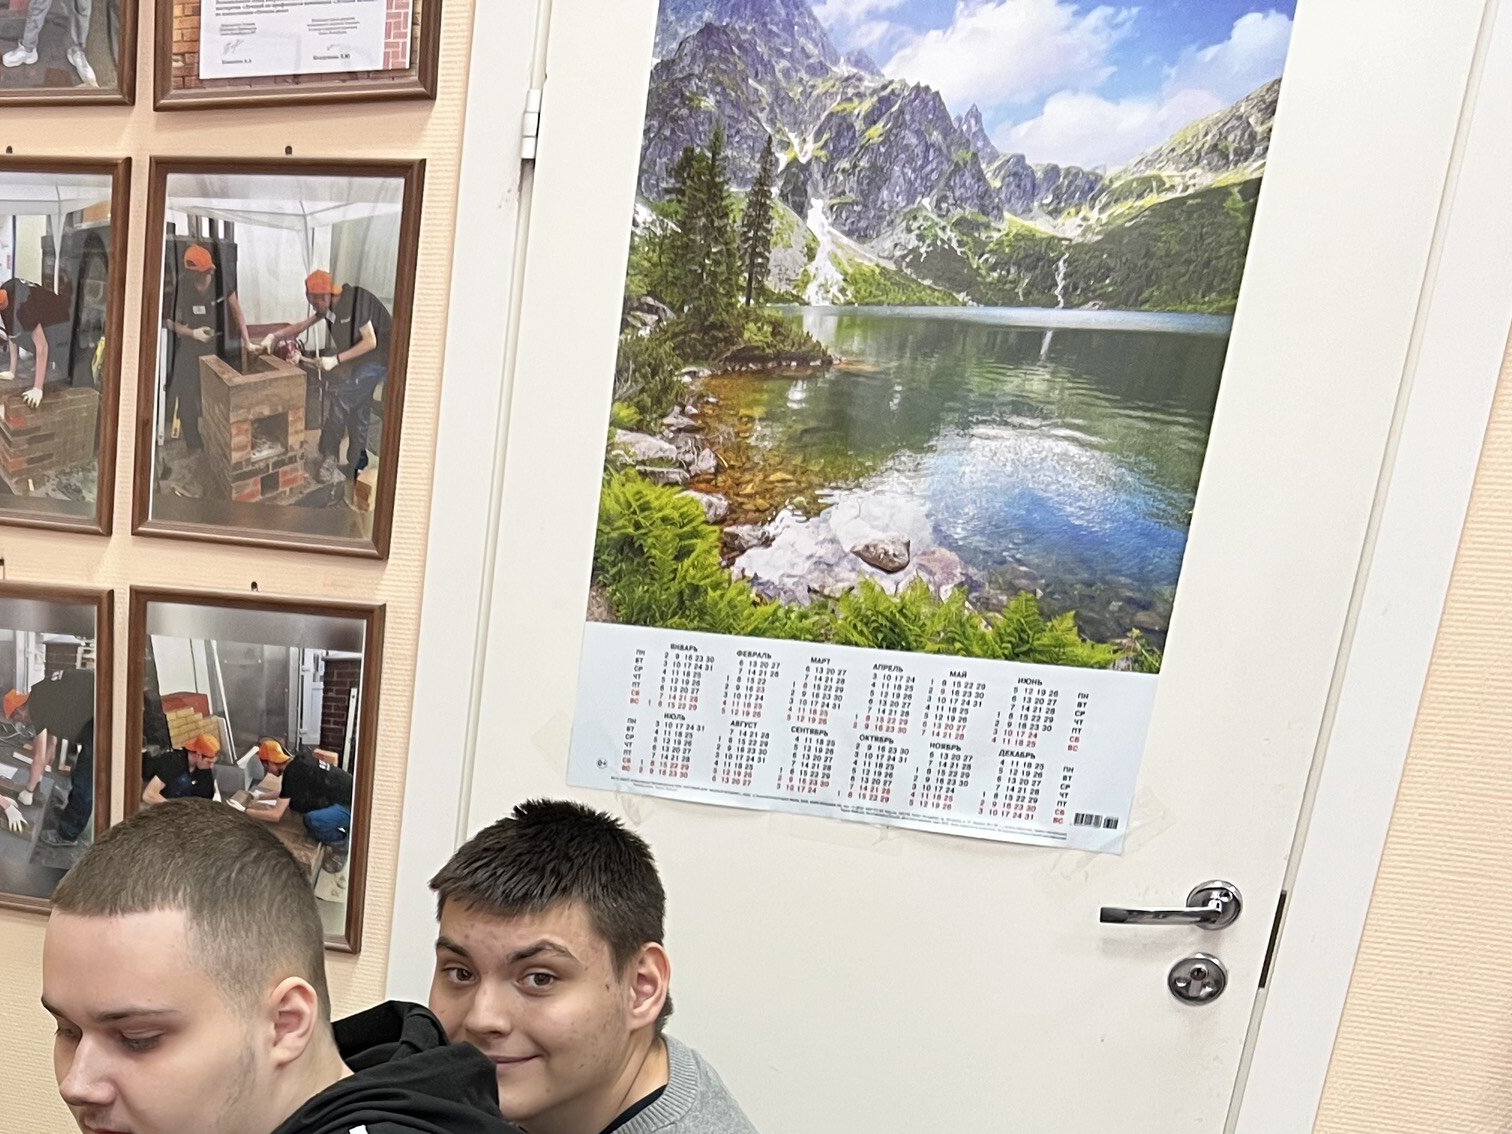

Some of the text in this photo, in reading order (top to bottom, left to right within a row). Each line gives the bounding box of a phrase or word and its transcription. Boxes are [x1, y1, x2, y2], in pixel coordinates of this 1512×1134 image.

[670, 643, 698, 652] ЯНВАРЬ
[736, 650, 772, 659] ФЕВРАЛЬ
[873, 663, 904, 673] АПРЕЛЬ
[1018, 677, 1043, 686] ИЮНЬ
[664, 713, 686, 721] ИЮЛЬ
[730, 720, 758, 729] АВГУСТ
[791, 726, 829, 737] СЕНТЯБРЬ
[859, 734, 894, 744] ОКТЯБРЬ
[929, 742, 962, 751] НОЯБРЬ
[998, 749, 1036, 760] ДЕКАБРЬ
